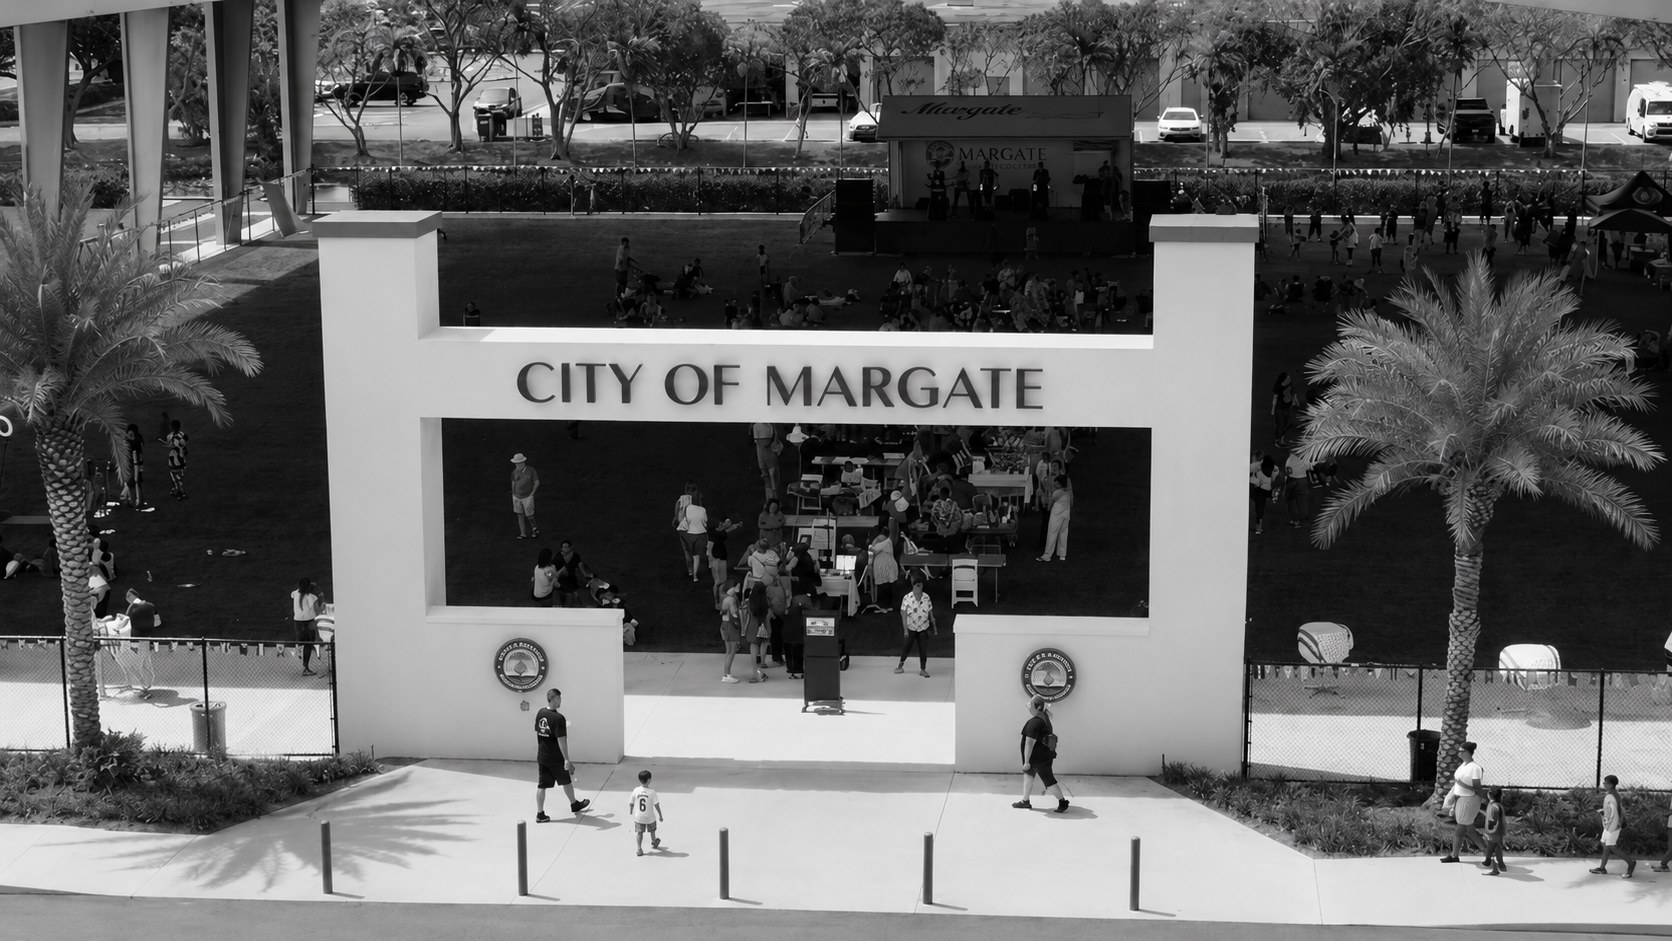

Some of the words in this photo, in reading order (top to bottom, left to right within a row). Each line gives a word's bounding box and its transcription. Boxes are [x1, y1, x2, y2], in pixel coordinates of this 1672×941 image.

[959, 147, 1047, 161] MARGATE
[516, 361, 644, 405] CITY
[664, 363, 742, 407] OF
[766, 365, 1045, 411] MARGATE
[639, 798, 647, 812] 6
